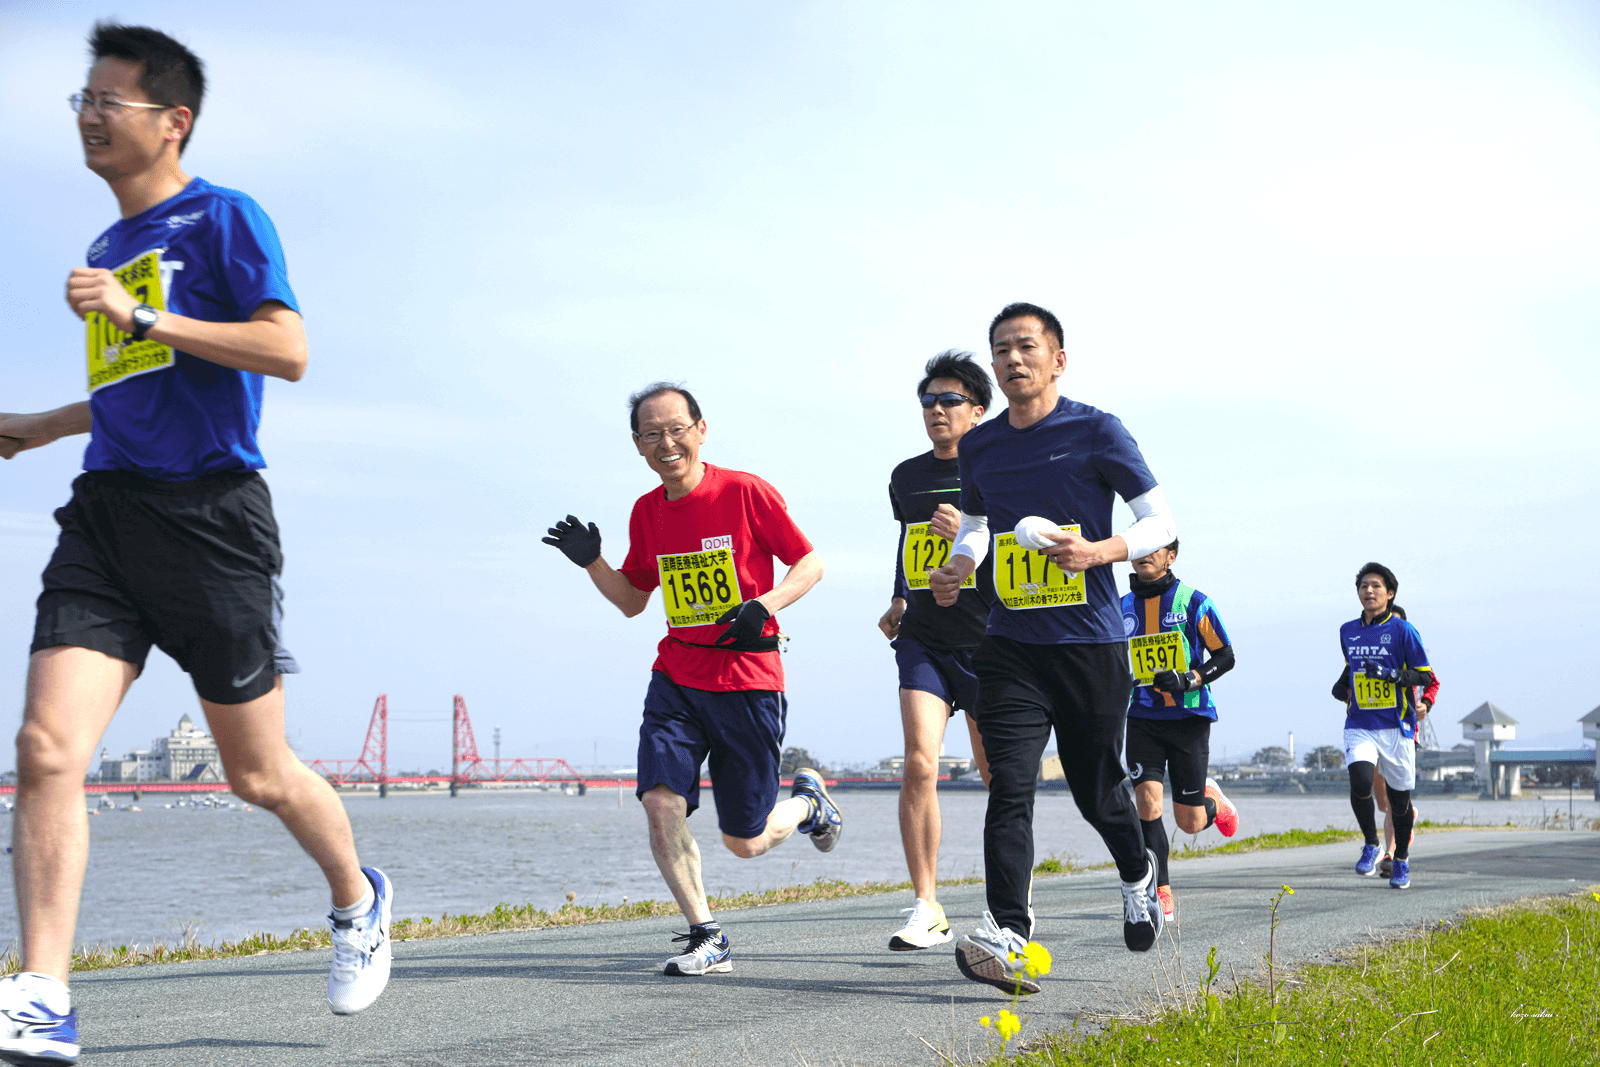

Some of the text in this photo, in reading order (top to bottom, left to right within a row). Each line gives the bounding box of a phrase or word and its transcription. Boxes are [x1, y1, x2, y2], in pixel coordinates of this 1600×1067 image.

[704, 537, 730, 550] QDH
[912, 538, 948, 572] 122
[661, 550, 728, 572] 国際医療福祉大学
[668, 567, 731, 609] 1568
[1135, 644, 1177, 674] 1597
[1358, 681, 1390, 700] 1158
